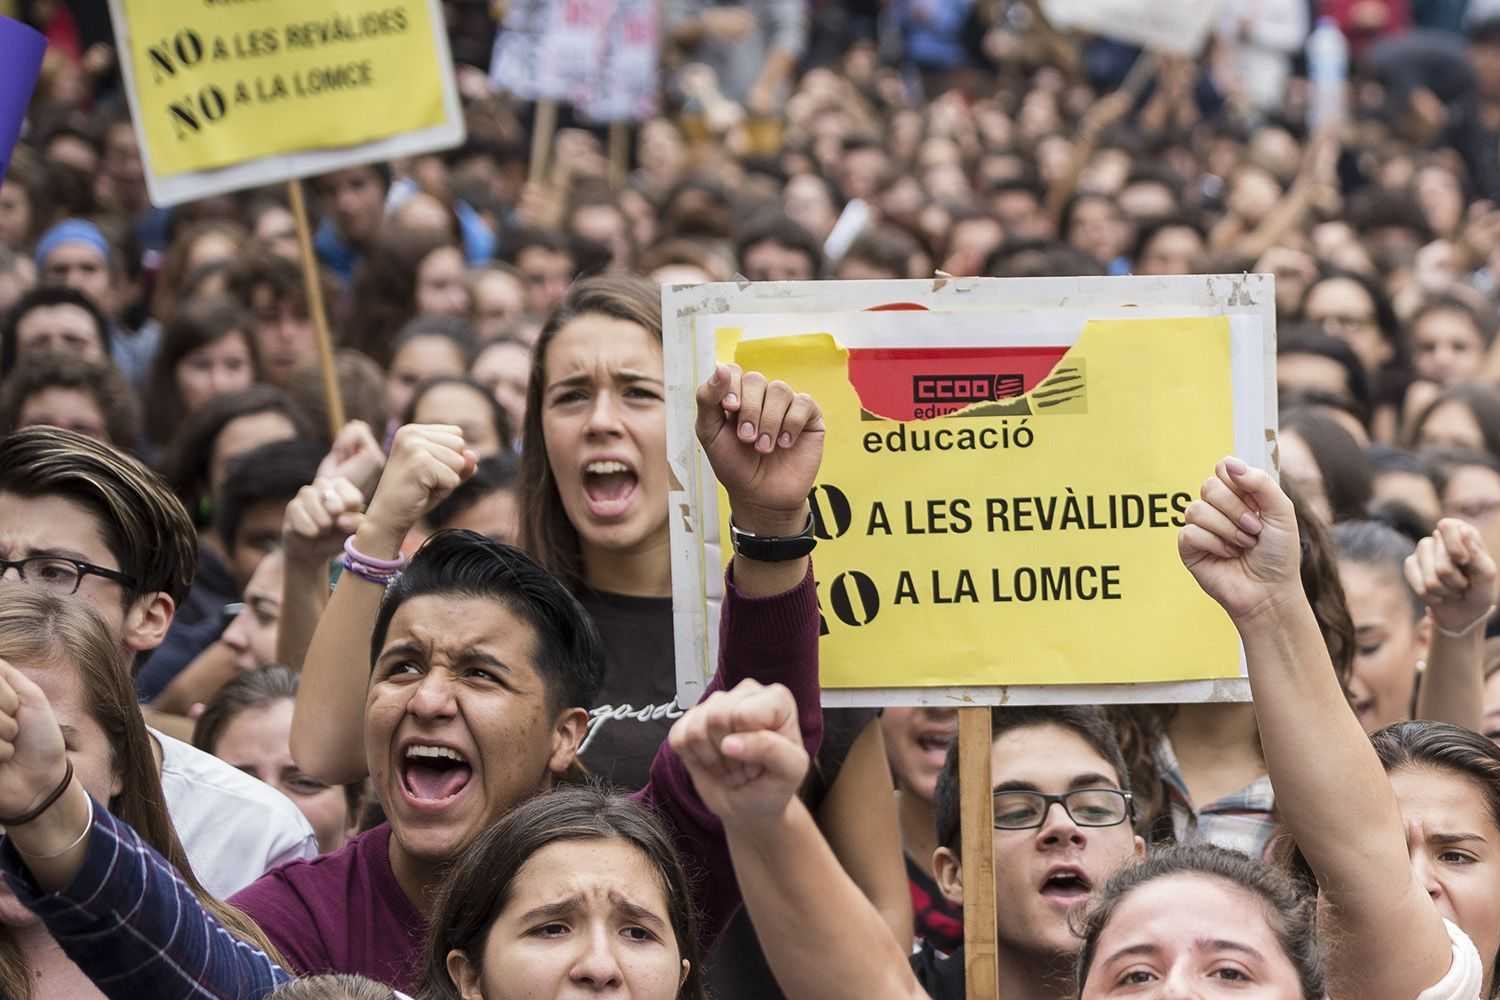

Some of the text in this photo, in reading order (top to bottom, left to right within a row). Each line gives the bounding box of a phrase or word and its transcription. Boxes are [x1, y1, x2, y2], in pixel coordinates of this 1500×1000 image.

[149, 28, 204, 85] NO
[213, 35, 230, 61] A
[235, 27, 279, 58] LES
[169, 60, 372, 140] NO A LA LOMCE
[918, 380, 989, 398] CCOO
[863, 419, 1034, 453] educació
[808, 484, 1192, 540] O A LES REVÀLIDES
[816, 566, 1122, 636] O A LA LOMCE
